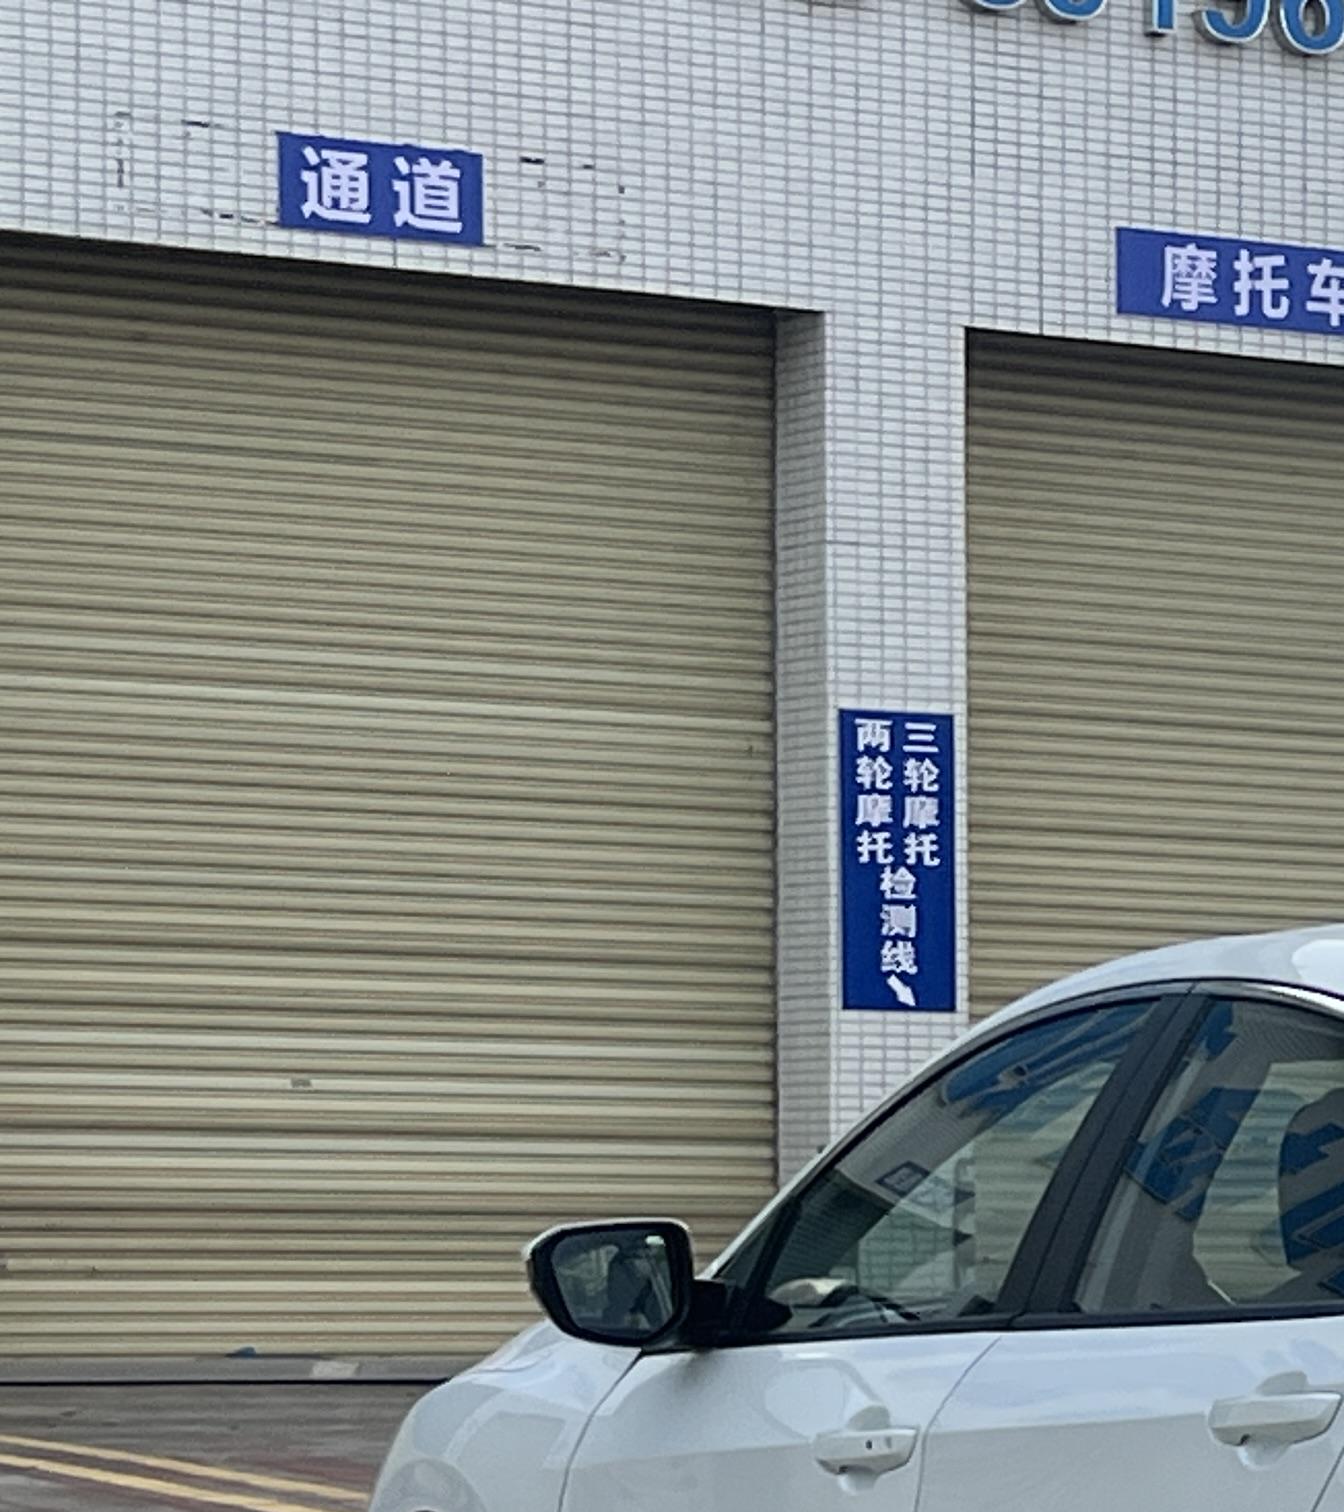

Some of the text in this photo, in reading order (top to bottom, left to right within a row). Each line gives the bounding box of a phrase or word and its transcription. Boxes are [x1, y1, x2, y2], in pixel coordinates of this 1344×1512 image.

[300, 144, 464, 235] 通道
[854, 718, 894, 864] 两轮摩托
[902, 722, 940, 866] 三轮摩托
[880, 865, 919, 975] 检测线
